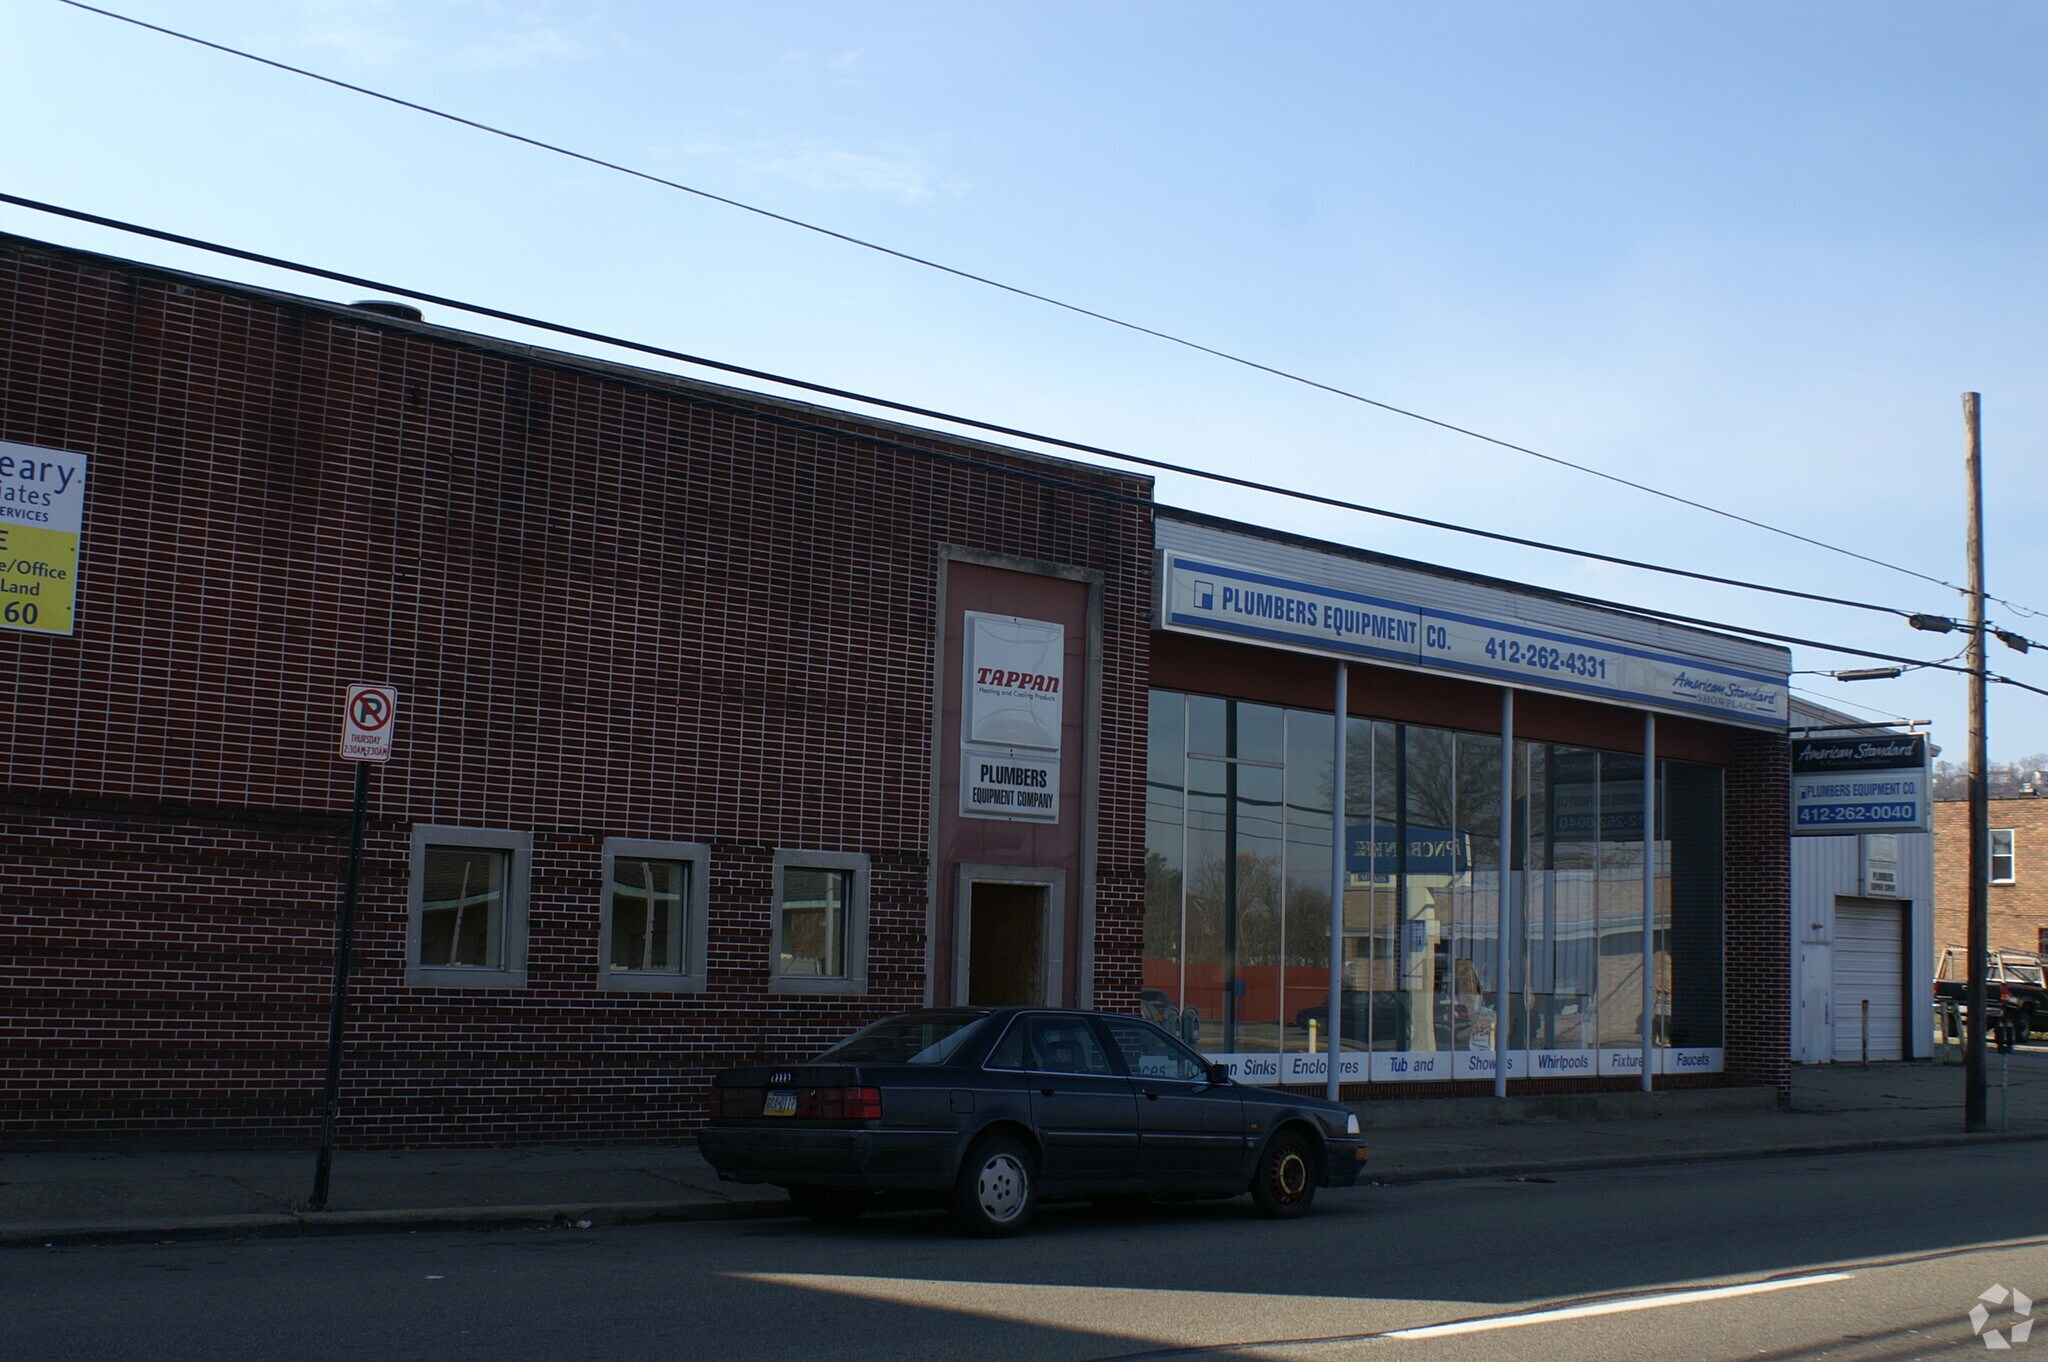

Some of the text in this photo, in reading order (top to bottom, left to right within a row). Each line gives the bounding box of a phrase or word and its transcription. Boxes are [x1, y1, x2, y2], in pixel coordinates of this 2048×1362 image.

[1, 578, 40, 596] Land
[4, 601, 38, 625] 60
[1222, 586, 1451, 650] PLUMBERS EQUIPMENT CO.
[1485, 637, 1606, 679] 412-262-4331
[977, 668, 1060, 693] TAPPAN
[1672, 671, 1777, 704] American Standard
[979, 687, 1000, 697] Heating
[1013, 690, 1034, 700] Cooling
[1035, 693, 1056, 702] Products
[1696, 693, 1757, 711] SHOWPLACE
[351, 734, 381, 745] THURSDAY
[1798, 740, 1917, 761] American Standard
[980, 764, 1047, 788] PLUMBERS
[972, 787, 1054, 809] EQUIPMENT COMPANY
[1806, 782, 1917, 797] PLUMBERS EQUIPMENT CO.
[1800, 806, 1912, 820] 412-262-0040
[1244, 1059, 1277, 1076] Sinks
[1293, 1058, 1359, 1074] Enclores
[1390, 1057, 1434, 1072] Tub and
[1469, 1055, 1513, 1070] Shows
[1538, 1055, 1588, 1070] Whirlpools
[1612, 1053, 1643, 1067] Fixture
[1676, 1053, 1710, 1066] Faucets
